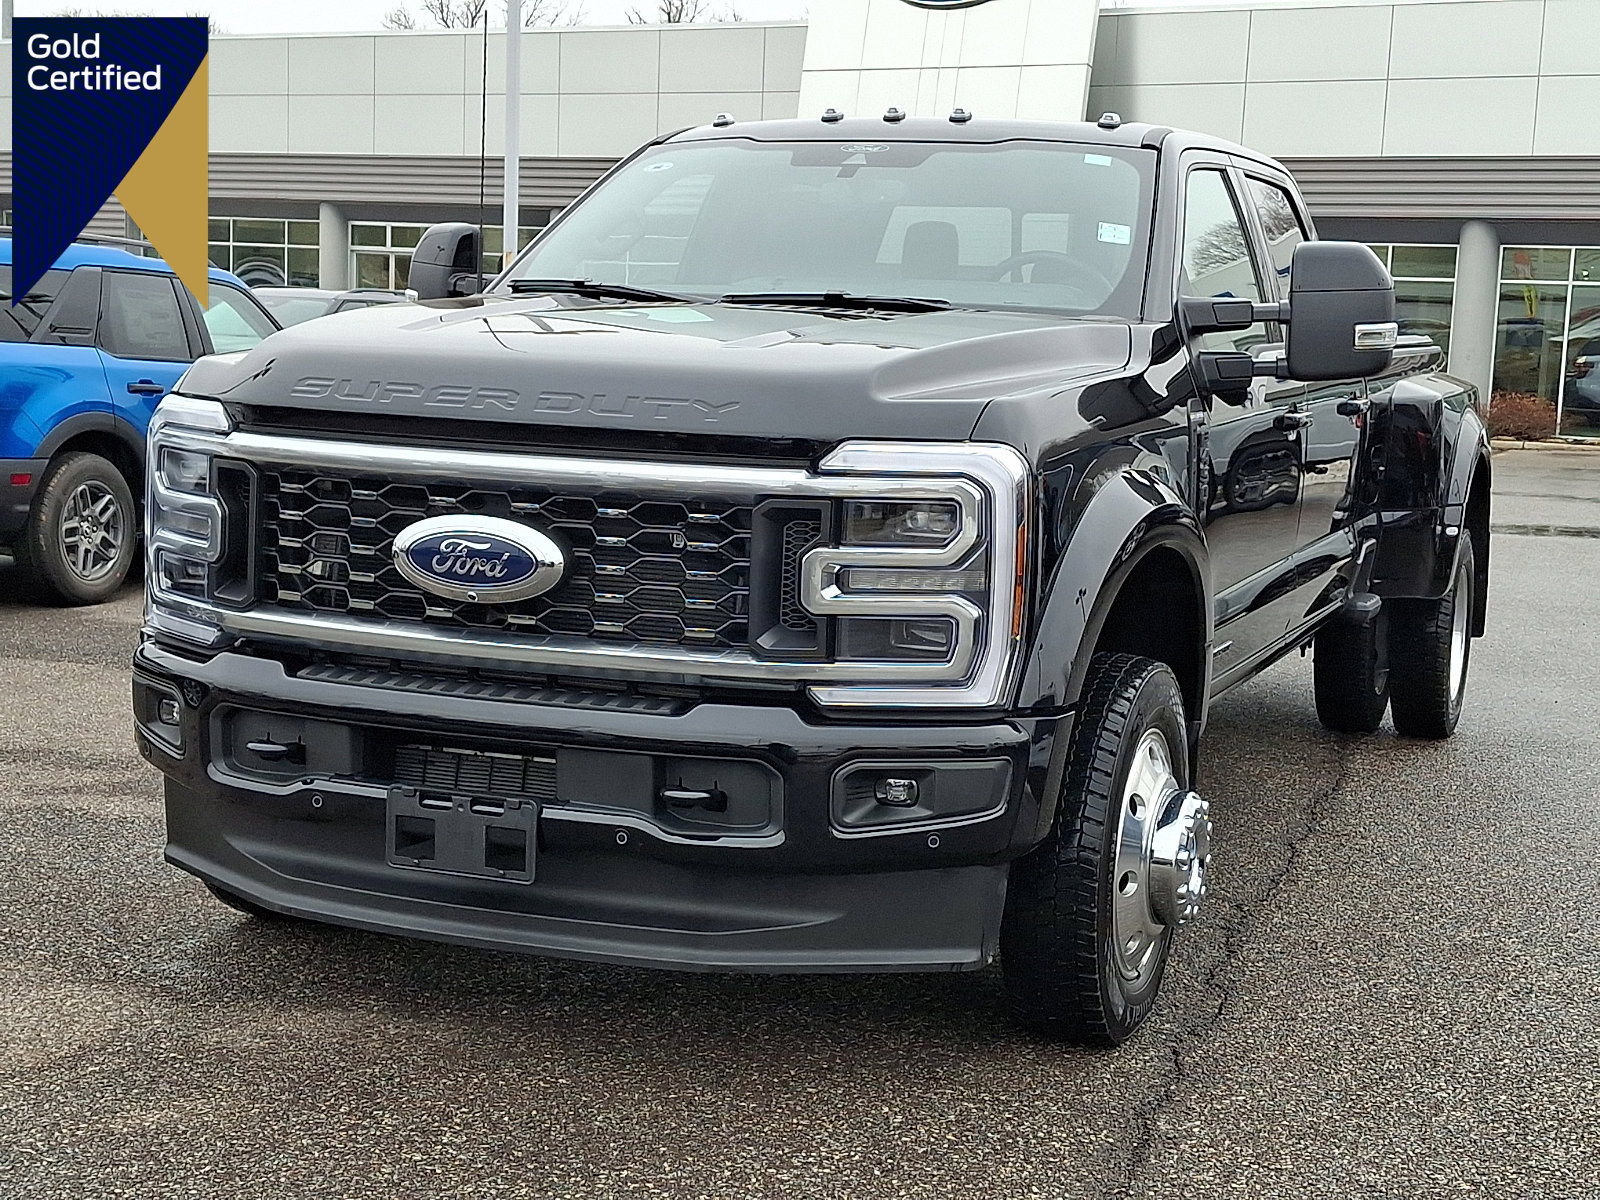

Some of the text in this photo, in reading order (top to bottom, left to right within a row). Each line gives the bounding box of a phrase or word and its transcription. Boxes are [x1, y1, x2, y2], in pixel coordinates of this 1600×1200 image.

[290, 376, 741, 422] SUPER DUTY
[431, 538, 512, 578] Ford
